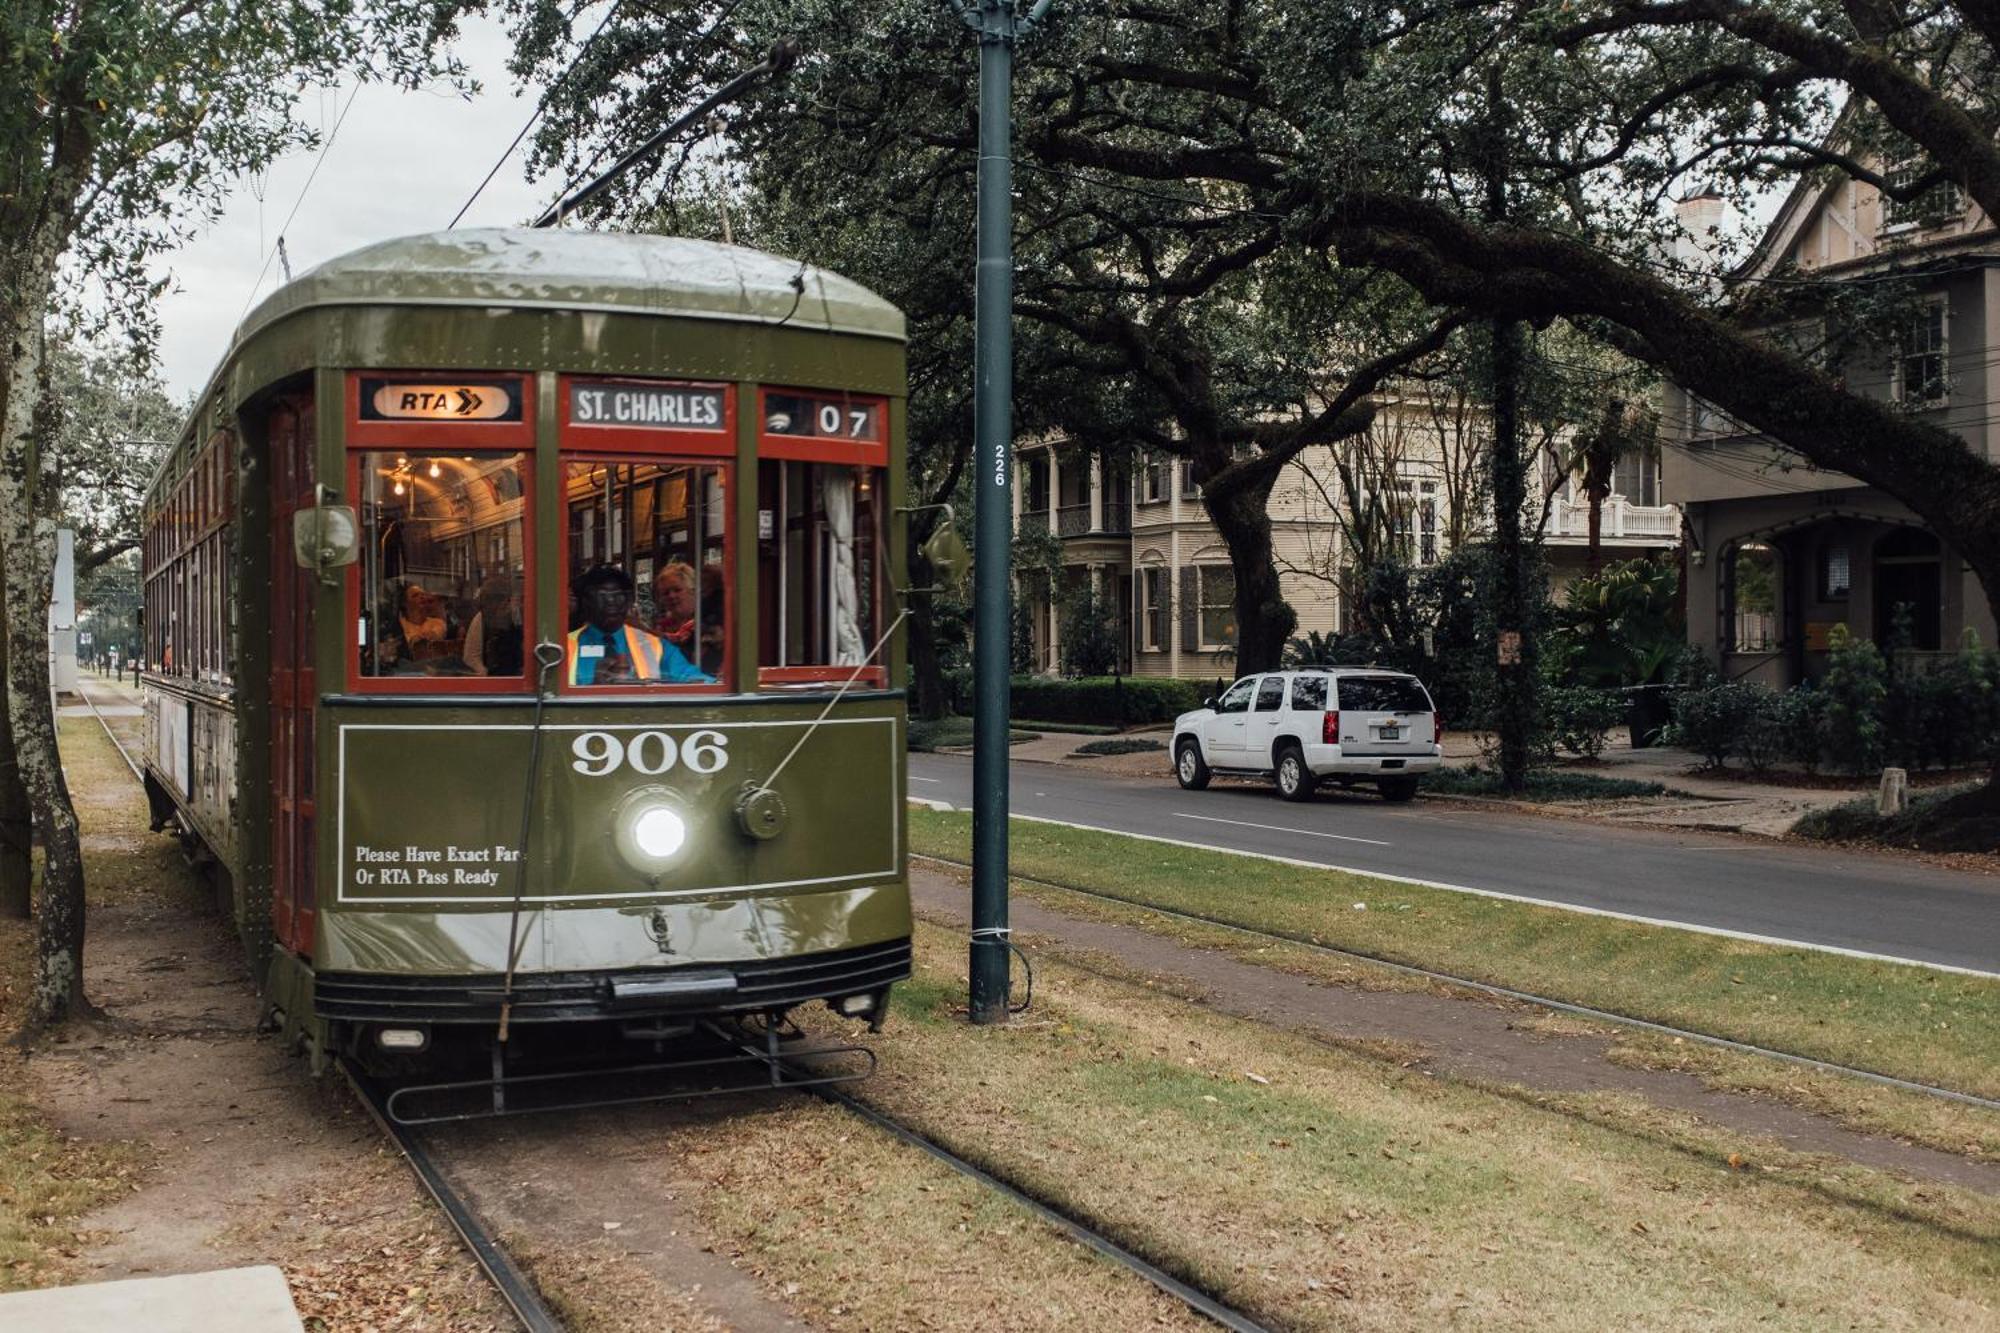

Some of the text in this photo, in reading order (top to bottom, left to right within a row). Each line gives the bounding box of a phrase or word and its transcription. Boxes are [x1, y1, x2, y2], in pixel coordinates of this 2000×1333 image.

[400, 391, 448, 411] RTA
[578, 391, 718, 425] ST. CHARLES
[995, 444, 1005, 486] 226
[571, 730, 729, 776] 906
[356, 846, 521, 862] Please Have Exact Far
[355, 868, 499, 887] Or RTA Pass Ready
